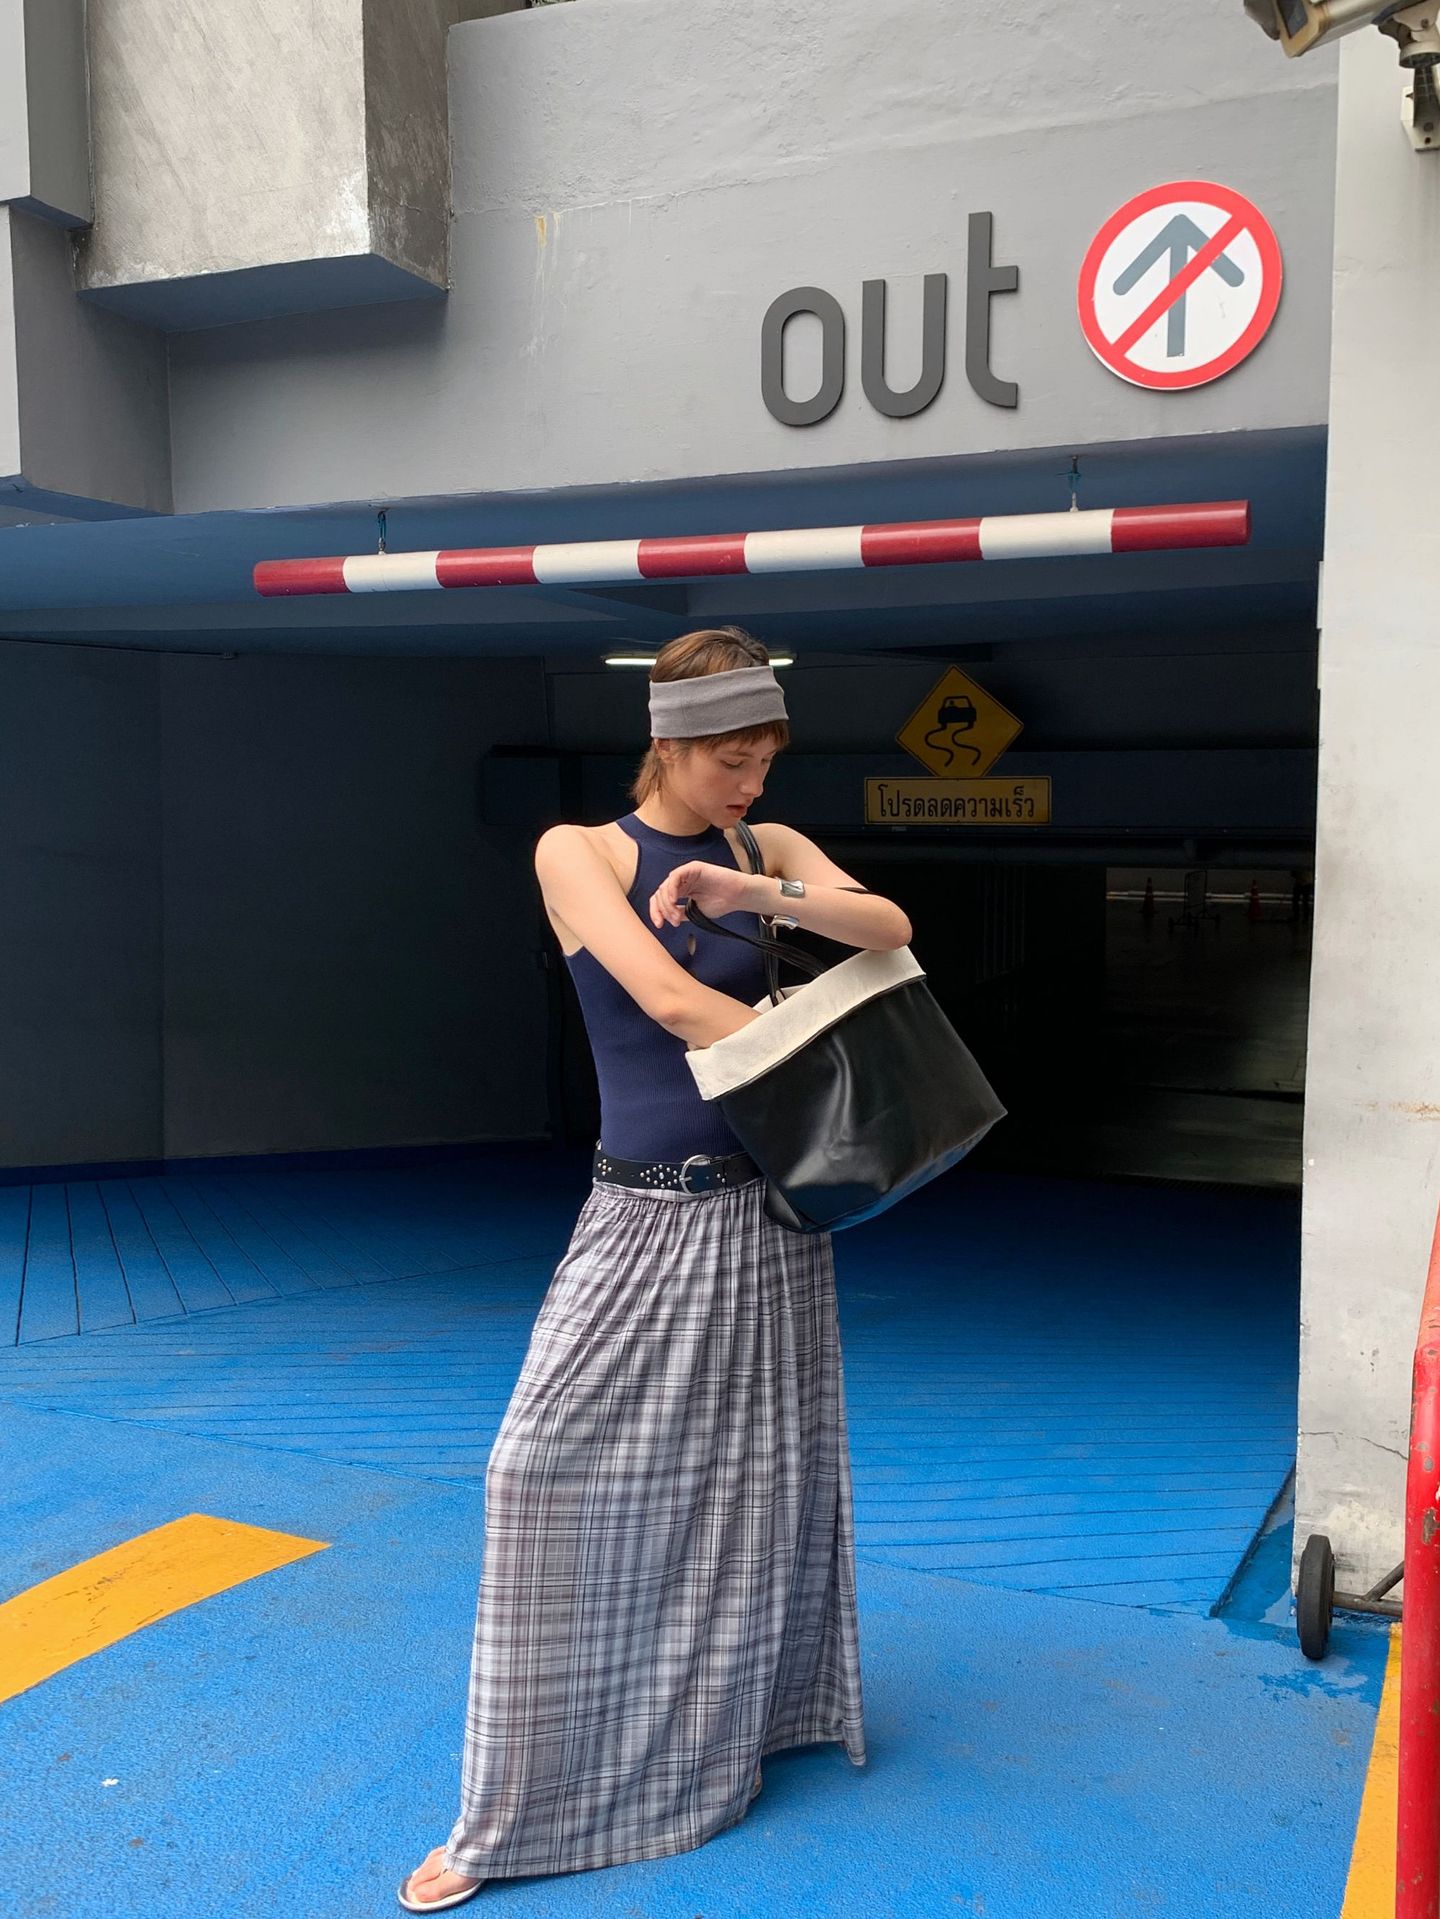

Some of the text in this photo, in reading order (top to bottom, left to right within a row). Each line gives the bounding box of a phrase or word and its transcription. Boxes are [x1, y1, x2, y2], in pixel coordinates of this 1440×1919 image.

[761, 212, 1018, 426] out
[878, 784, 1035, 818] โปรดลดความเร็ว
